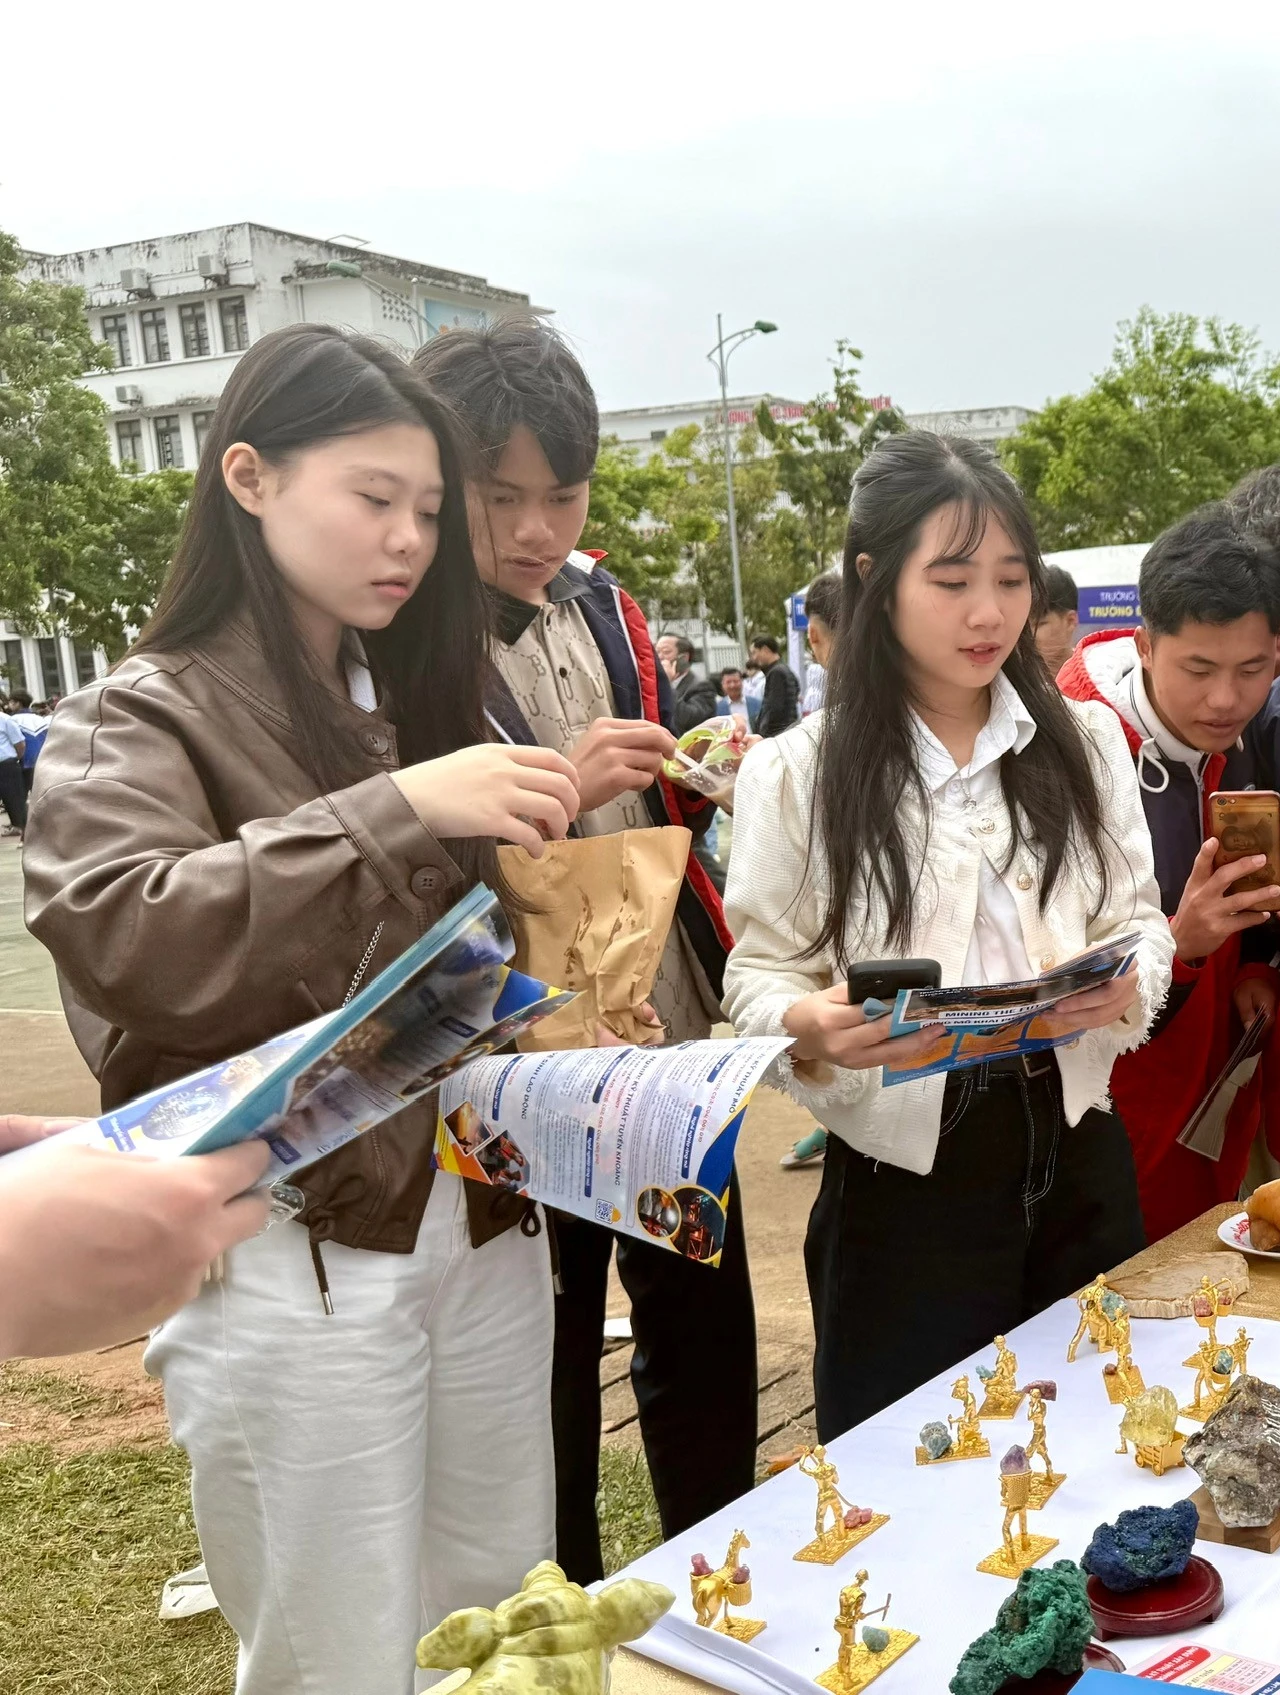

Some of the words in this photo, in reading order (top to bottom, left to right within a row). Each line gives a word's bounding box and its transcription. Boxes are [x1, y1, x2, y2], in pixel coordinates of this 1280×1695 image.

[1088, 603, 1134, 618] TRƯỜNG
[526, 1076, 536, 1093] LAO
[631, 1081, 640, 1092] KỸ
[734, 1070, 753, 1097] THUẬT
[521, 1094, 530, 1120] ĐỘNG
[620, 1091, 634, 1121] THUẬT
[728, 1097, 739, 1114] MỎ
[616, 1122, 627, 1149] TUYỂN
[614, 1149, 622, 1187] KHOÁNG
